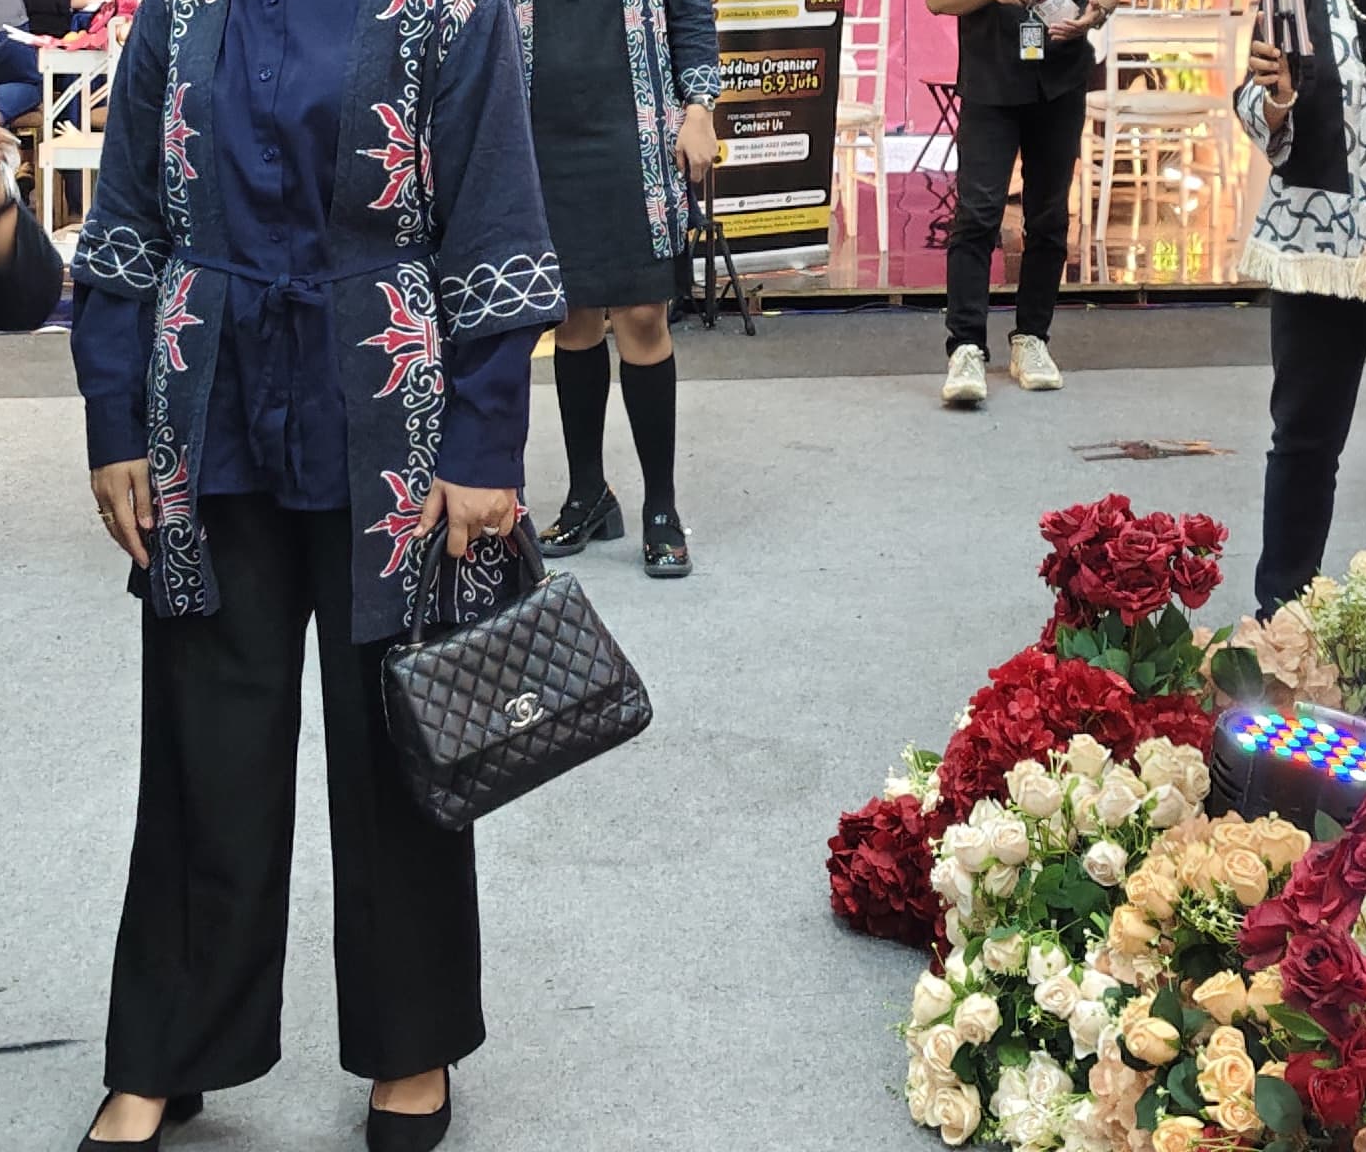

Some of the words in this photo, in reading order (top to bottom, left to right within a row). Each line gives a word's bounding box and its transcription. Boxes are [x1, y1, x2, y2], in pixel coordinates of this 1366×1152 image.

[719, 59, 760, 75] edding
[761, 58, 818, 75] Organizer
[737, 76, 762, 90] From
[762, 75, 786, 93] 6.9
[790, 73, 819, 89] Juta
[734, 120, 771, 134] Contact
[772, 118, 784, 131] Us
